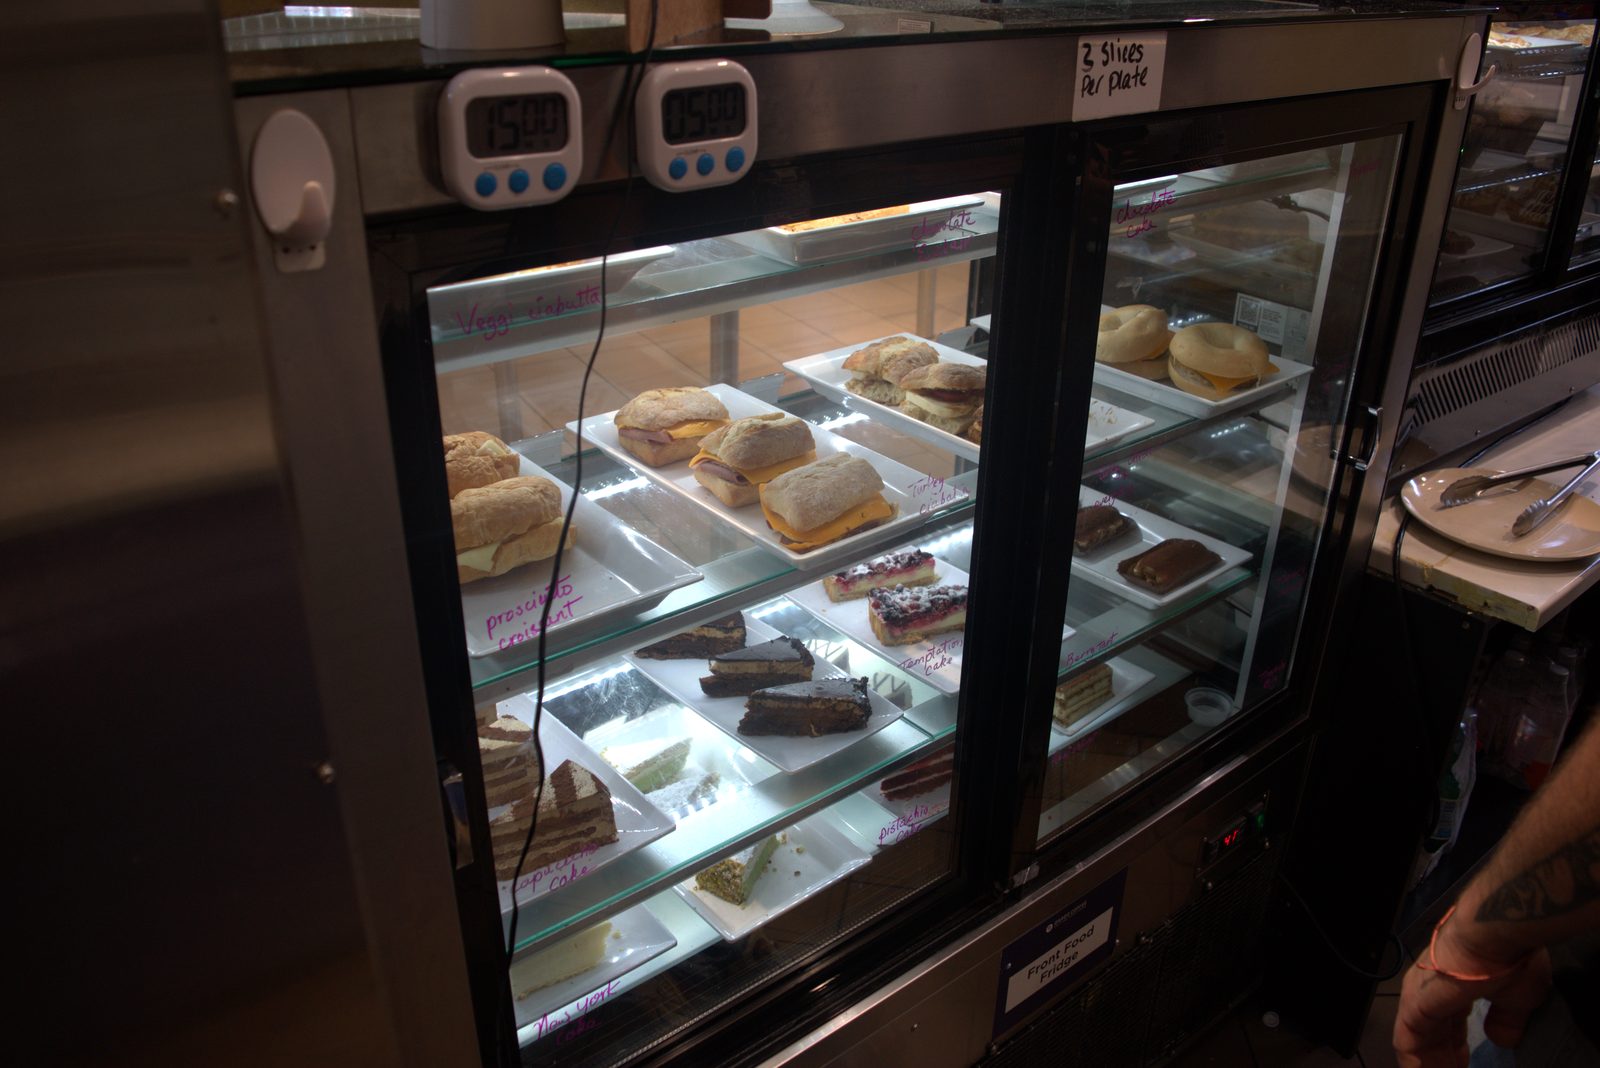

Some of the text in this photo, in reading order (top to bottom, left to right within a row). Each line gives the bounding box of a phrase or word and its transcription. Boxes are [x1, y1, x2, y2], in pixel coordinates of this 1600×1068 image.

[1027, 925, 1095, 980] Front Food
[1040, 951, 1079, 984] Fridge
